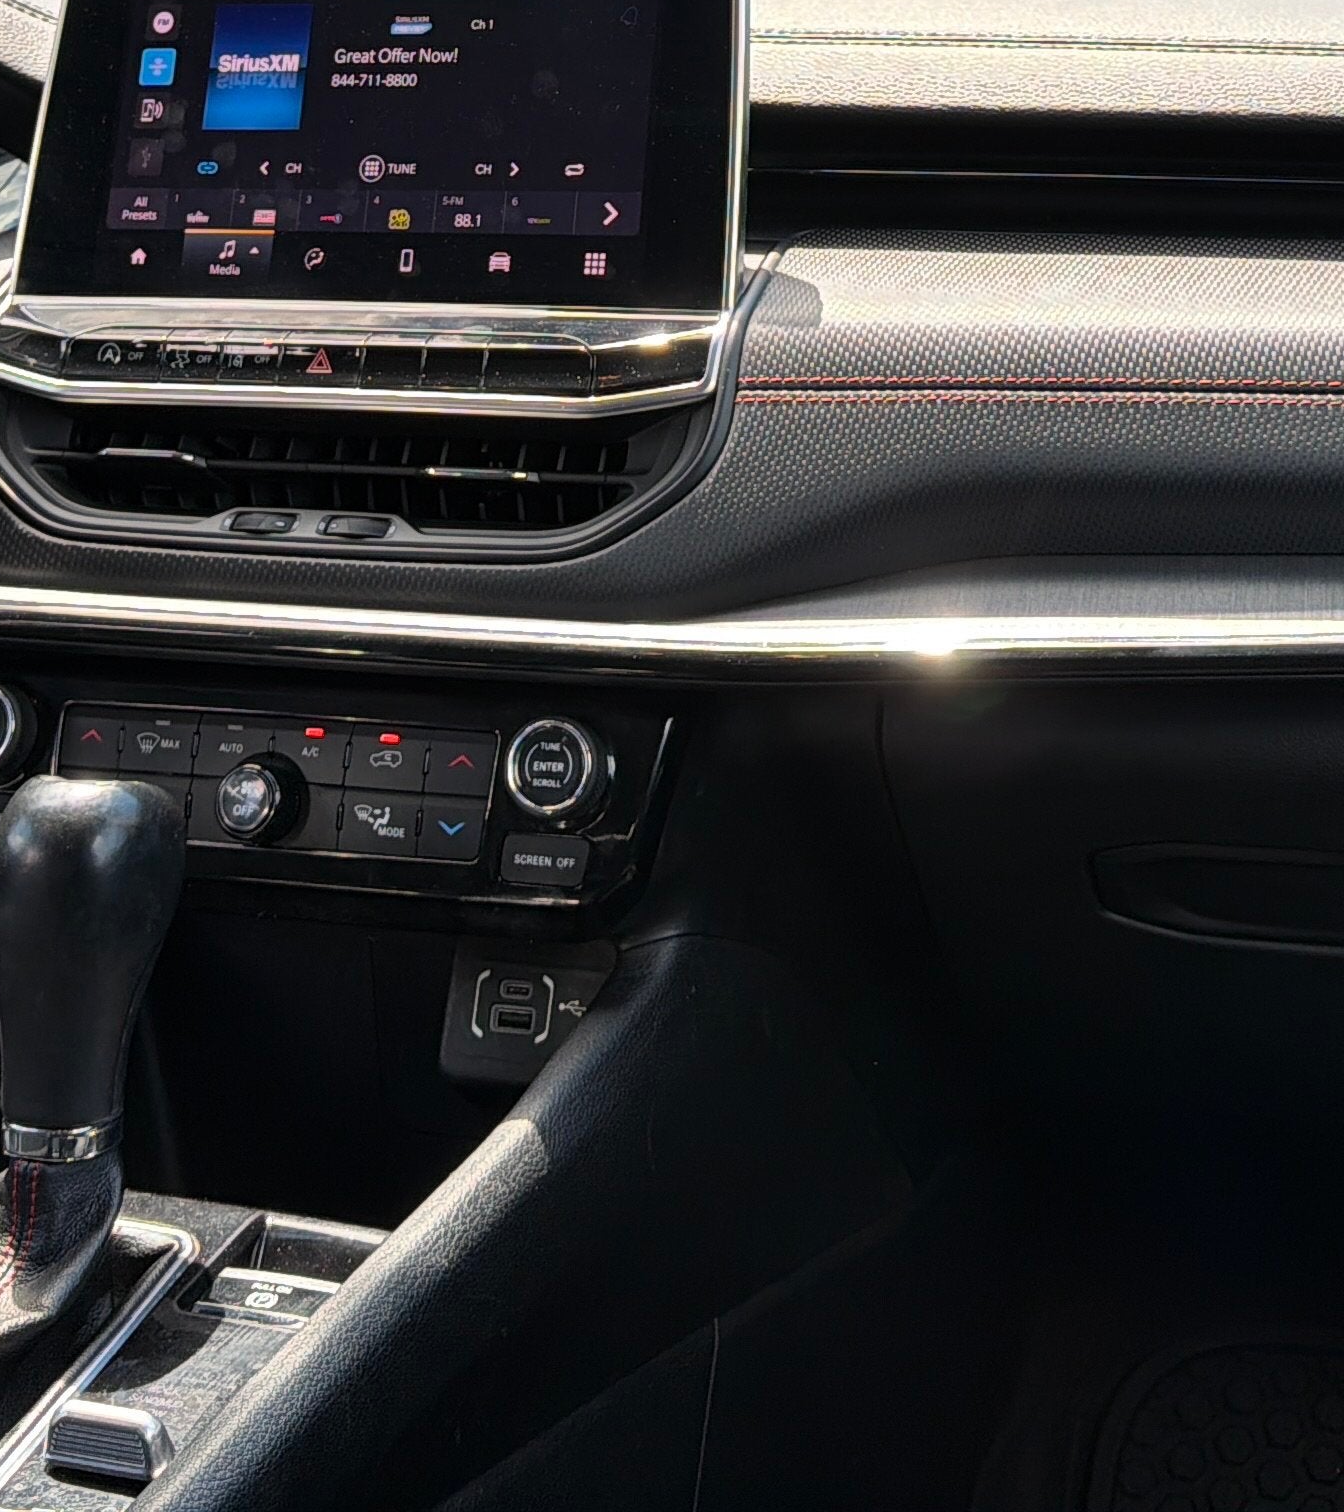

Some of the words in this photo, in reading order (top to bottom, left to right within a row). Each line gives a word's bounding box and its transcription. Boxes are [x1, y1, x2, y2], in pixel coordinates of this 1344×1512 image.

[157, 18, 171, 27] FM
[471, 19, 487, 30] Ch
[489, 19, 494, 30] 1
[334, 49, 375, 65] Great
[379, 48, 416, 65] Offer
[418, 48, 459, 63] Now!
[217, 54, 301, 74] SiriusXM
[331, 73, 418, 88] 844-711-8800
[285, 163, 302, 174] CH
[387, 163, 417, 175] TUNE
[475, 163, 492, 176] CH
[134, 196, 148, 208] All
[239, 195, 246, 204] 2
[306, 195, 312, 204] 3
[373, 196, 380, 205] 4
[442, 196, 464, 206] 5-FM
[511, 197, 519, 206] 6
[122, 210, 157, 221] Presets
[454, 213, 482, 228] 88.1
[209, 263, 241, 276] Media
[128, 352, 144, 362] OFF
[196, 354, 213, 364] OFF
[254, 355, 271, 364] OFF
[161, 739, 180, 750] MAX
[219, 742, 244, 754] AUTO
[540, 742, 561, 752] TUNE
[301, 747, 319, 758] A/C
[533, 761, 564, 772] ENTER
[532, 779, 561, 788] SCROLL
[232, 804, 254, 817] OFF
[378, 826, 405, 839] MODE
[514, 854, 552, 867] SCREEN
[557, 857, 576, 868] OFF
